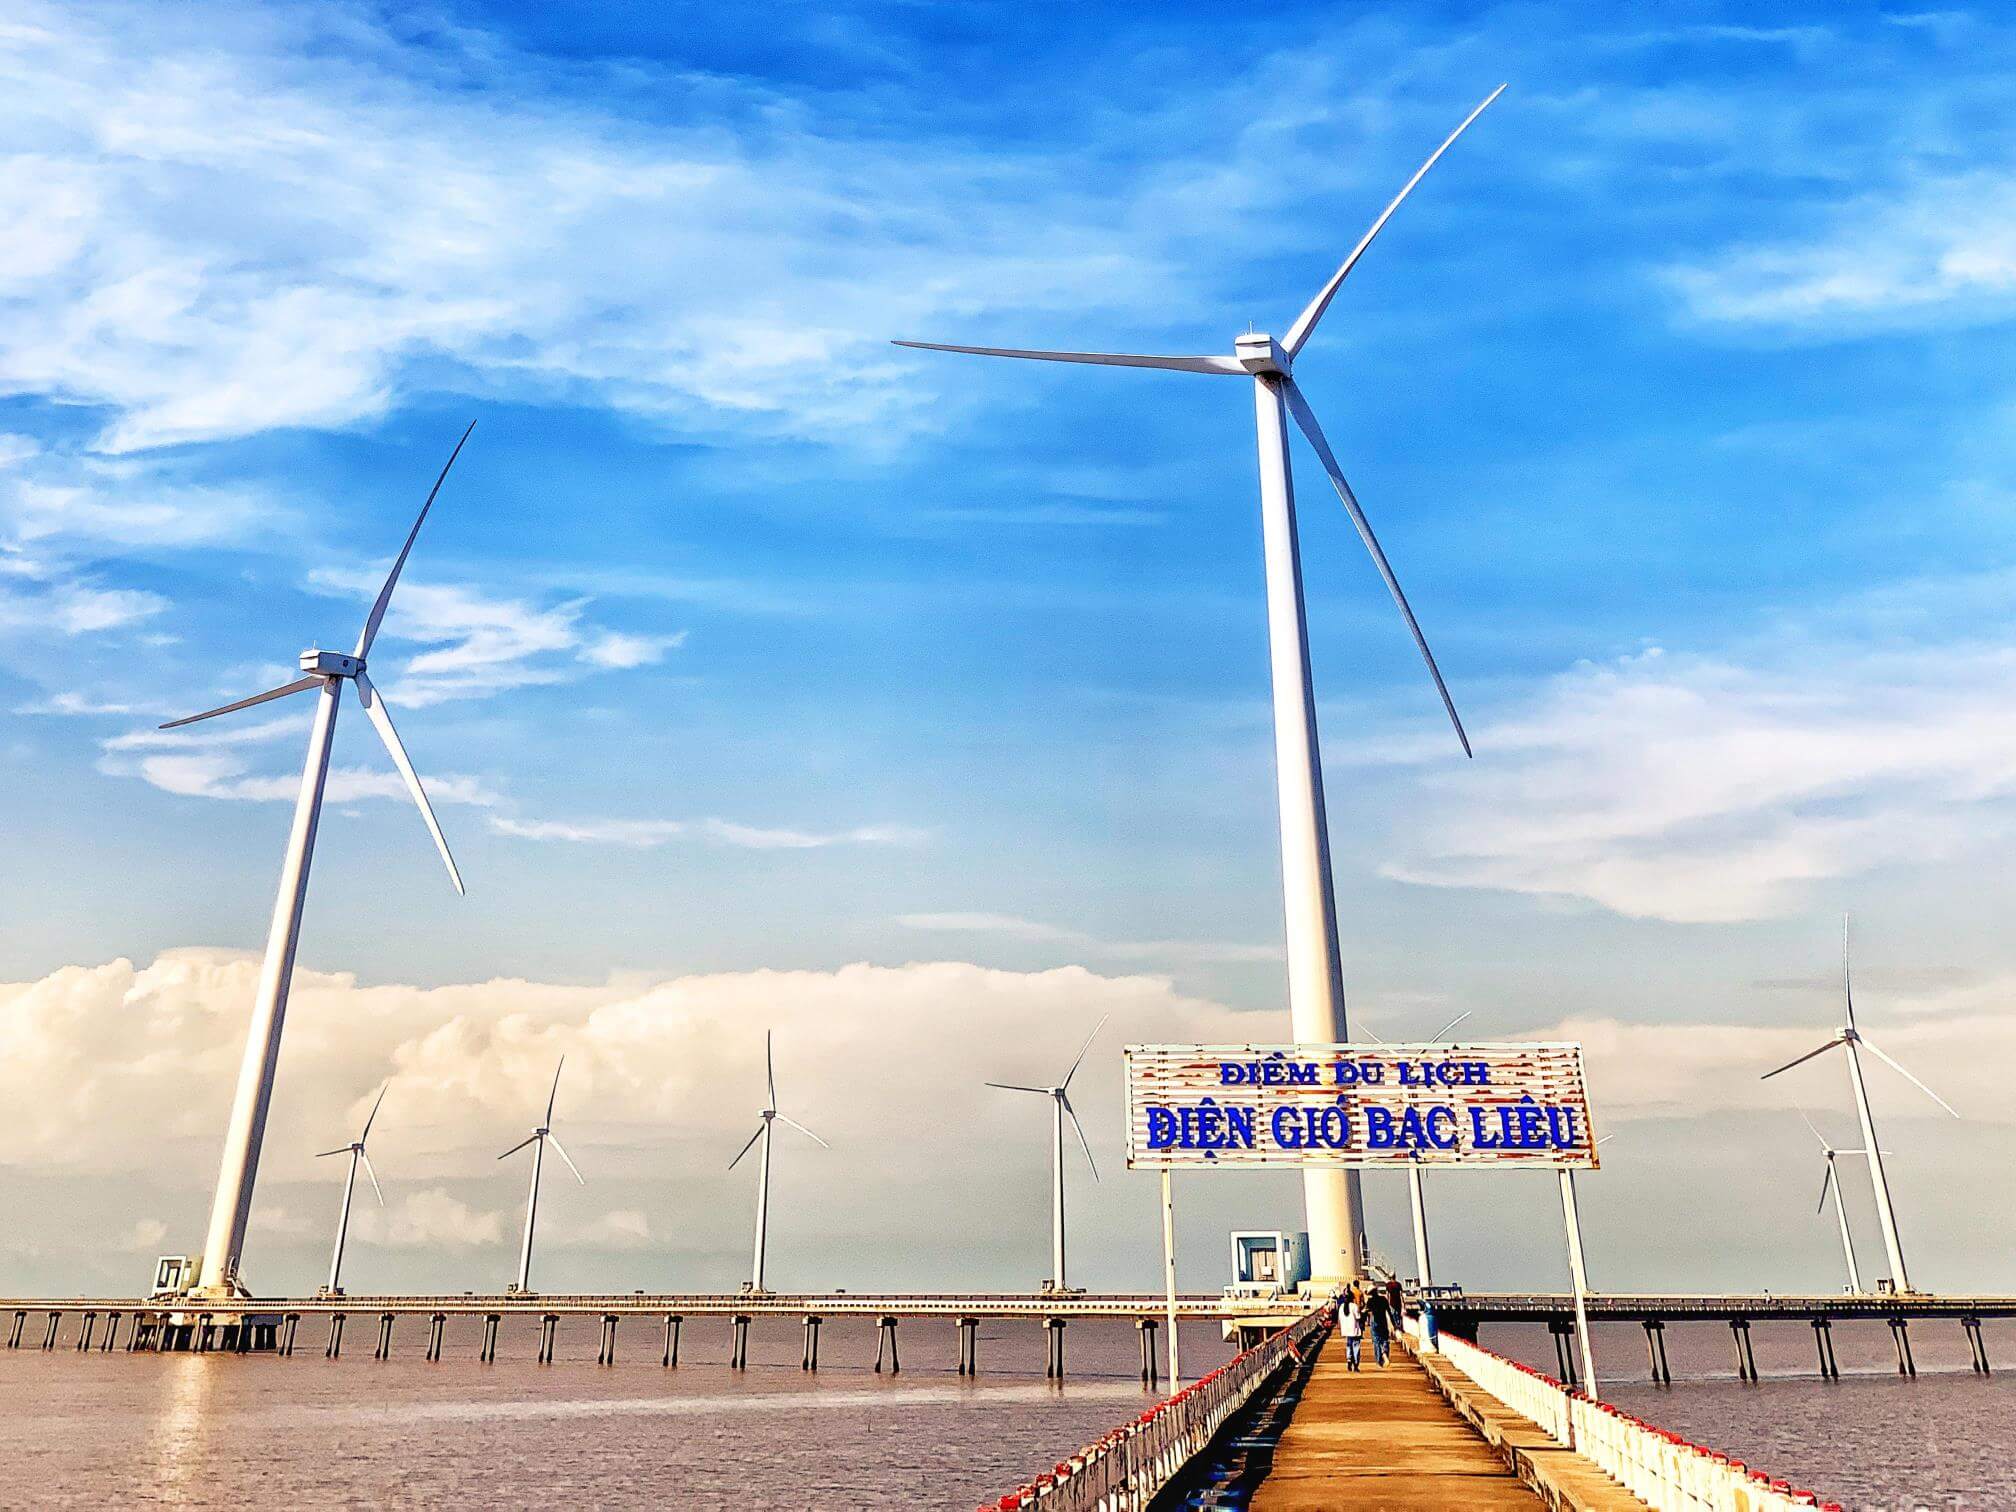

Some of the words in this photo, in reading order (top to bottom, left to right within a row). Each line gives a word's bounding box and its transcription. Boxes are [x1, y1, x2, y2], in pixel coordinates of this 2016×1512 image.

[1397, 1061, 1491, 1089] LỊCH
[1146, 1097, 1257, 1159] ĐIỆN
[1271, 1094, 1351, 1149] GIÓ
[1363, 1106, 1459, 1158] BẠC
[1467, 1094, 1578, 1150] LIÊU
